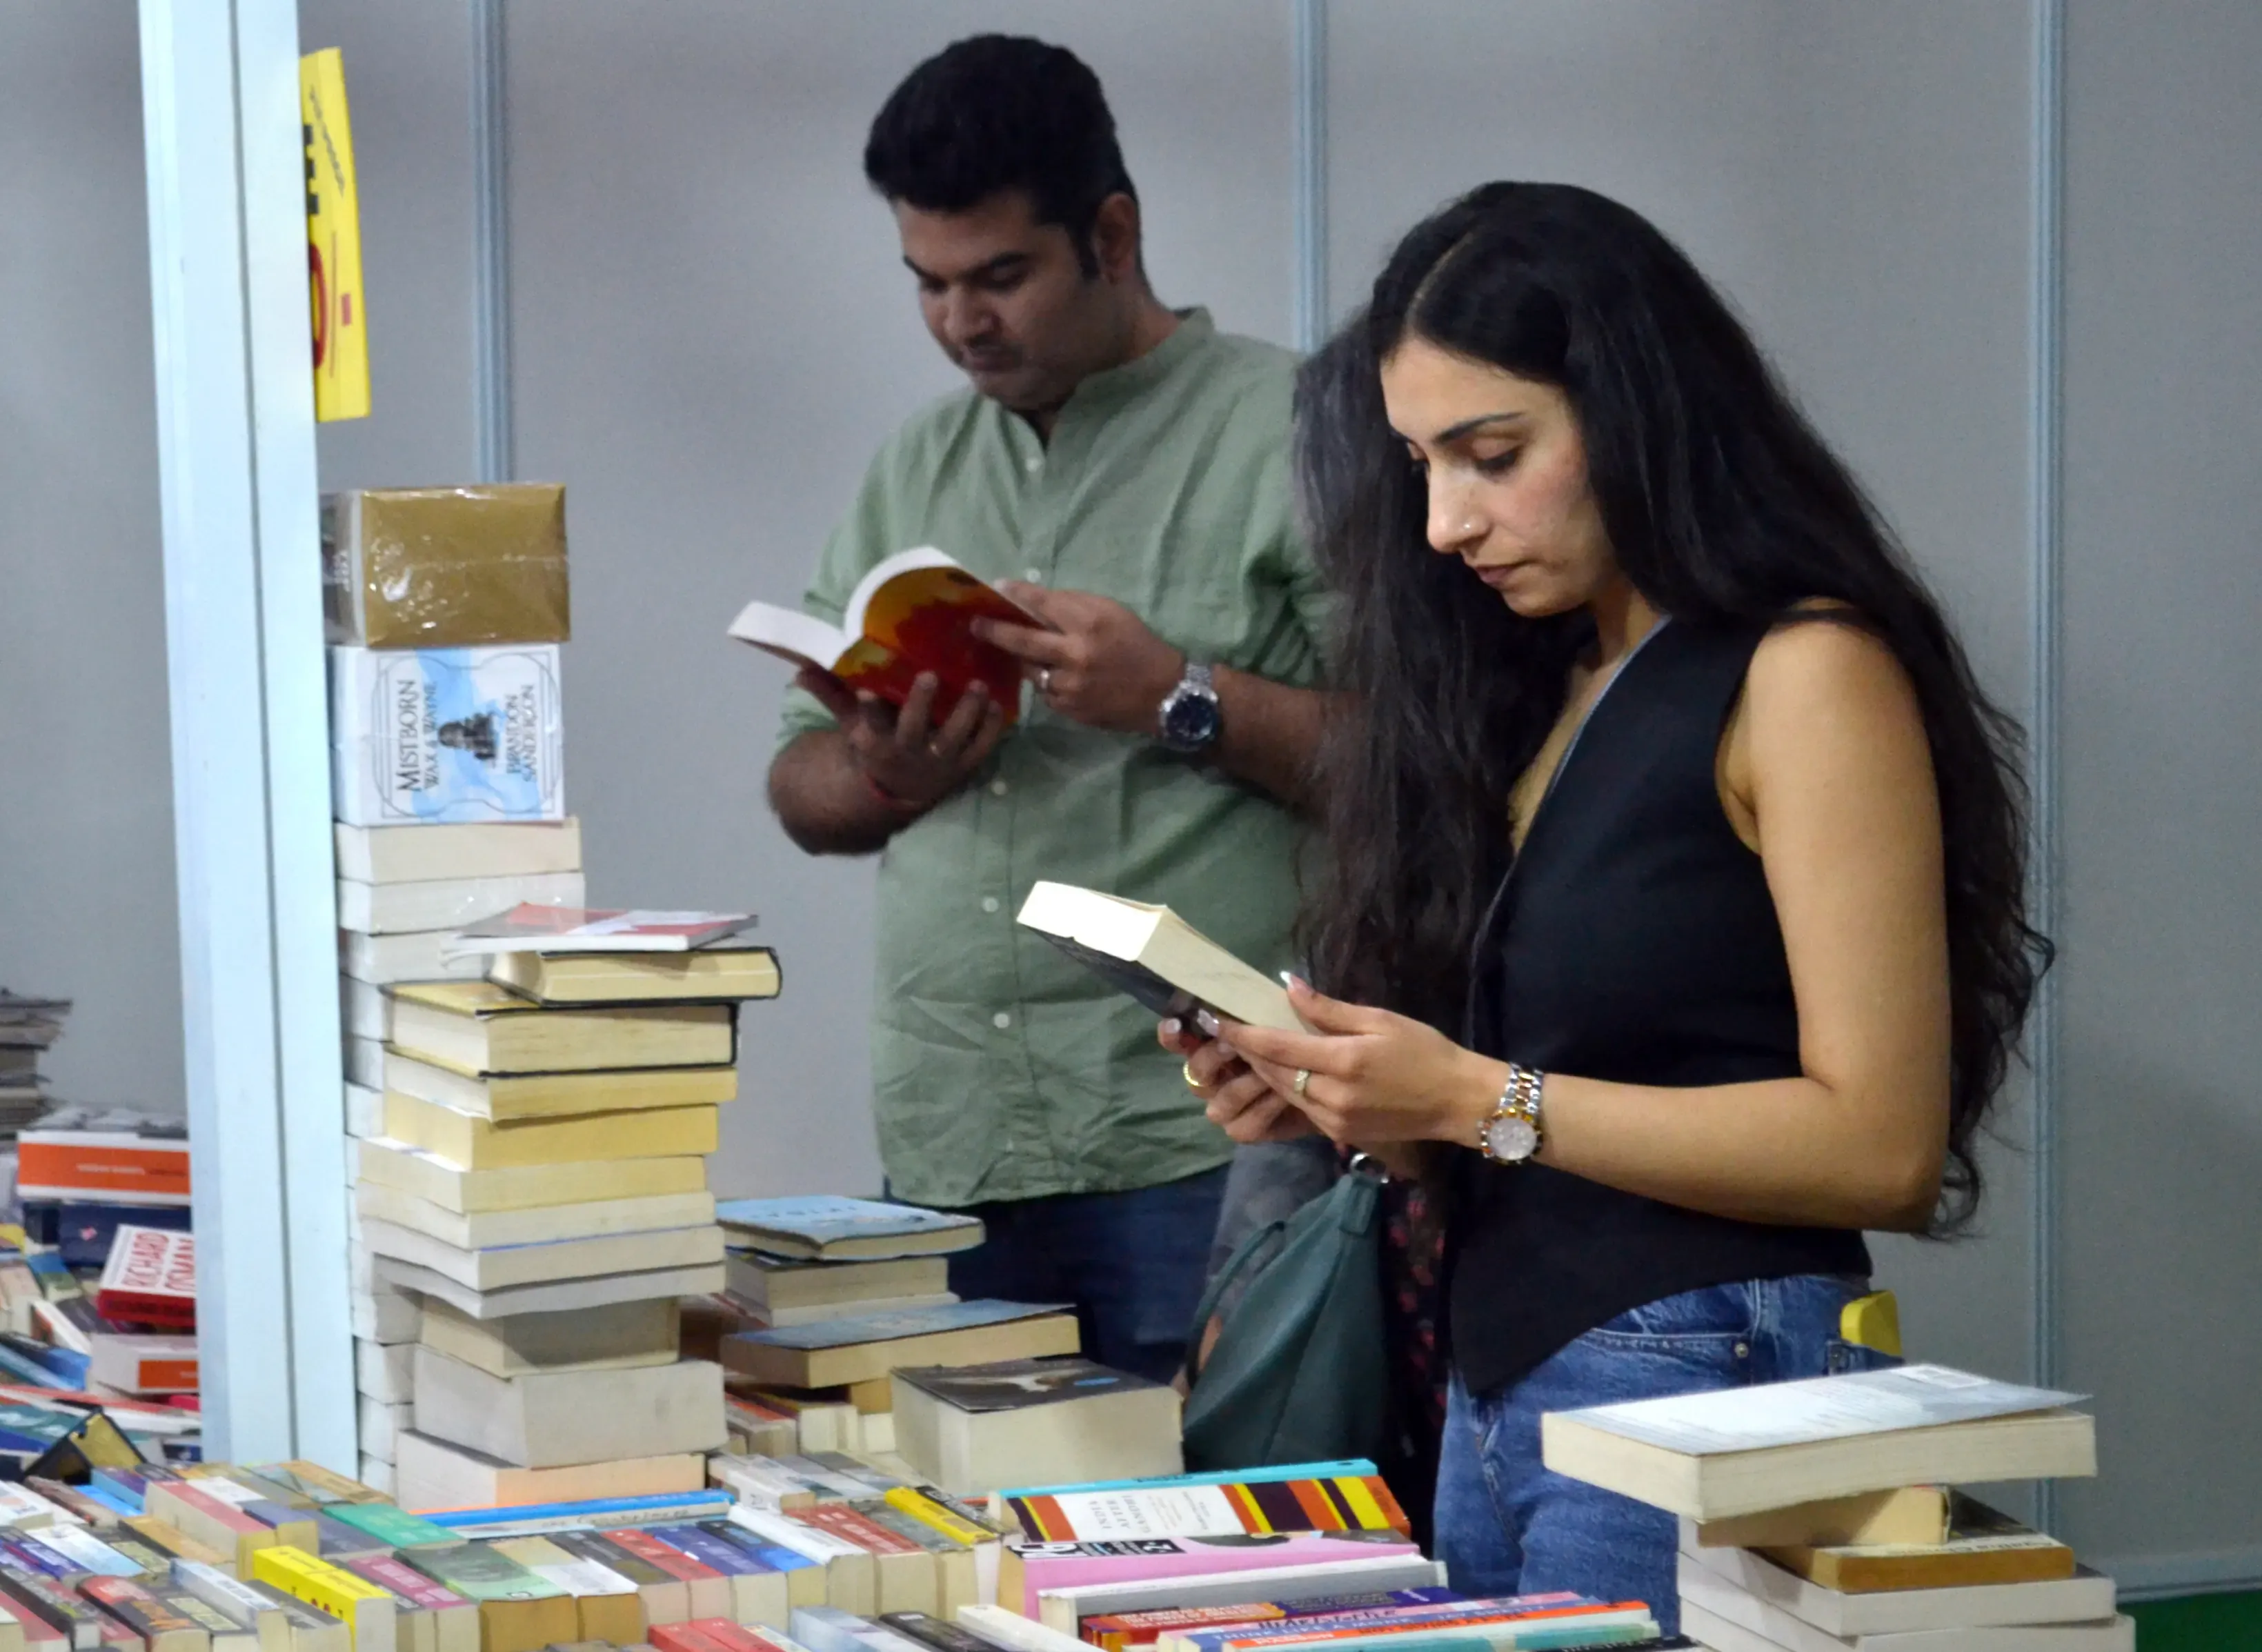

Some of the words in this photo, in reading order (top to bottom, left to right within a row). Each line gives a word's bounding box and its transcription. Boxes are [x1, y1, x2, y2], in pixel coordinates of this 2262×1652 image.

[422, 681, 438, 735] WAYNE
[505, 693, 522, 774] BRANDON
[520, 684, 537, 783] SANDERSON
[396, 680, 421, 791] MISTBORN
[423, 753, 439, 789] WAX
[121, 1231, 170, 1288] RICHARD
[1088, 1500, 1113, 1529] INDIA
[1106, 1499, 1131, 1529] AFTER
[1120, 1495, 1152, 1533] GANDHI
